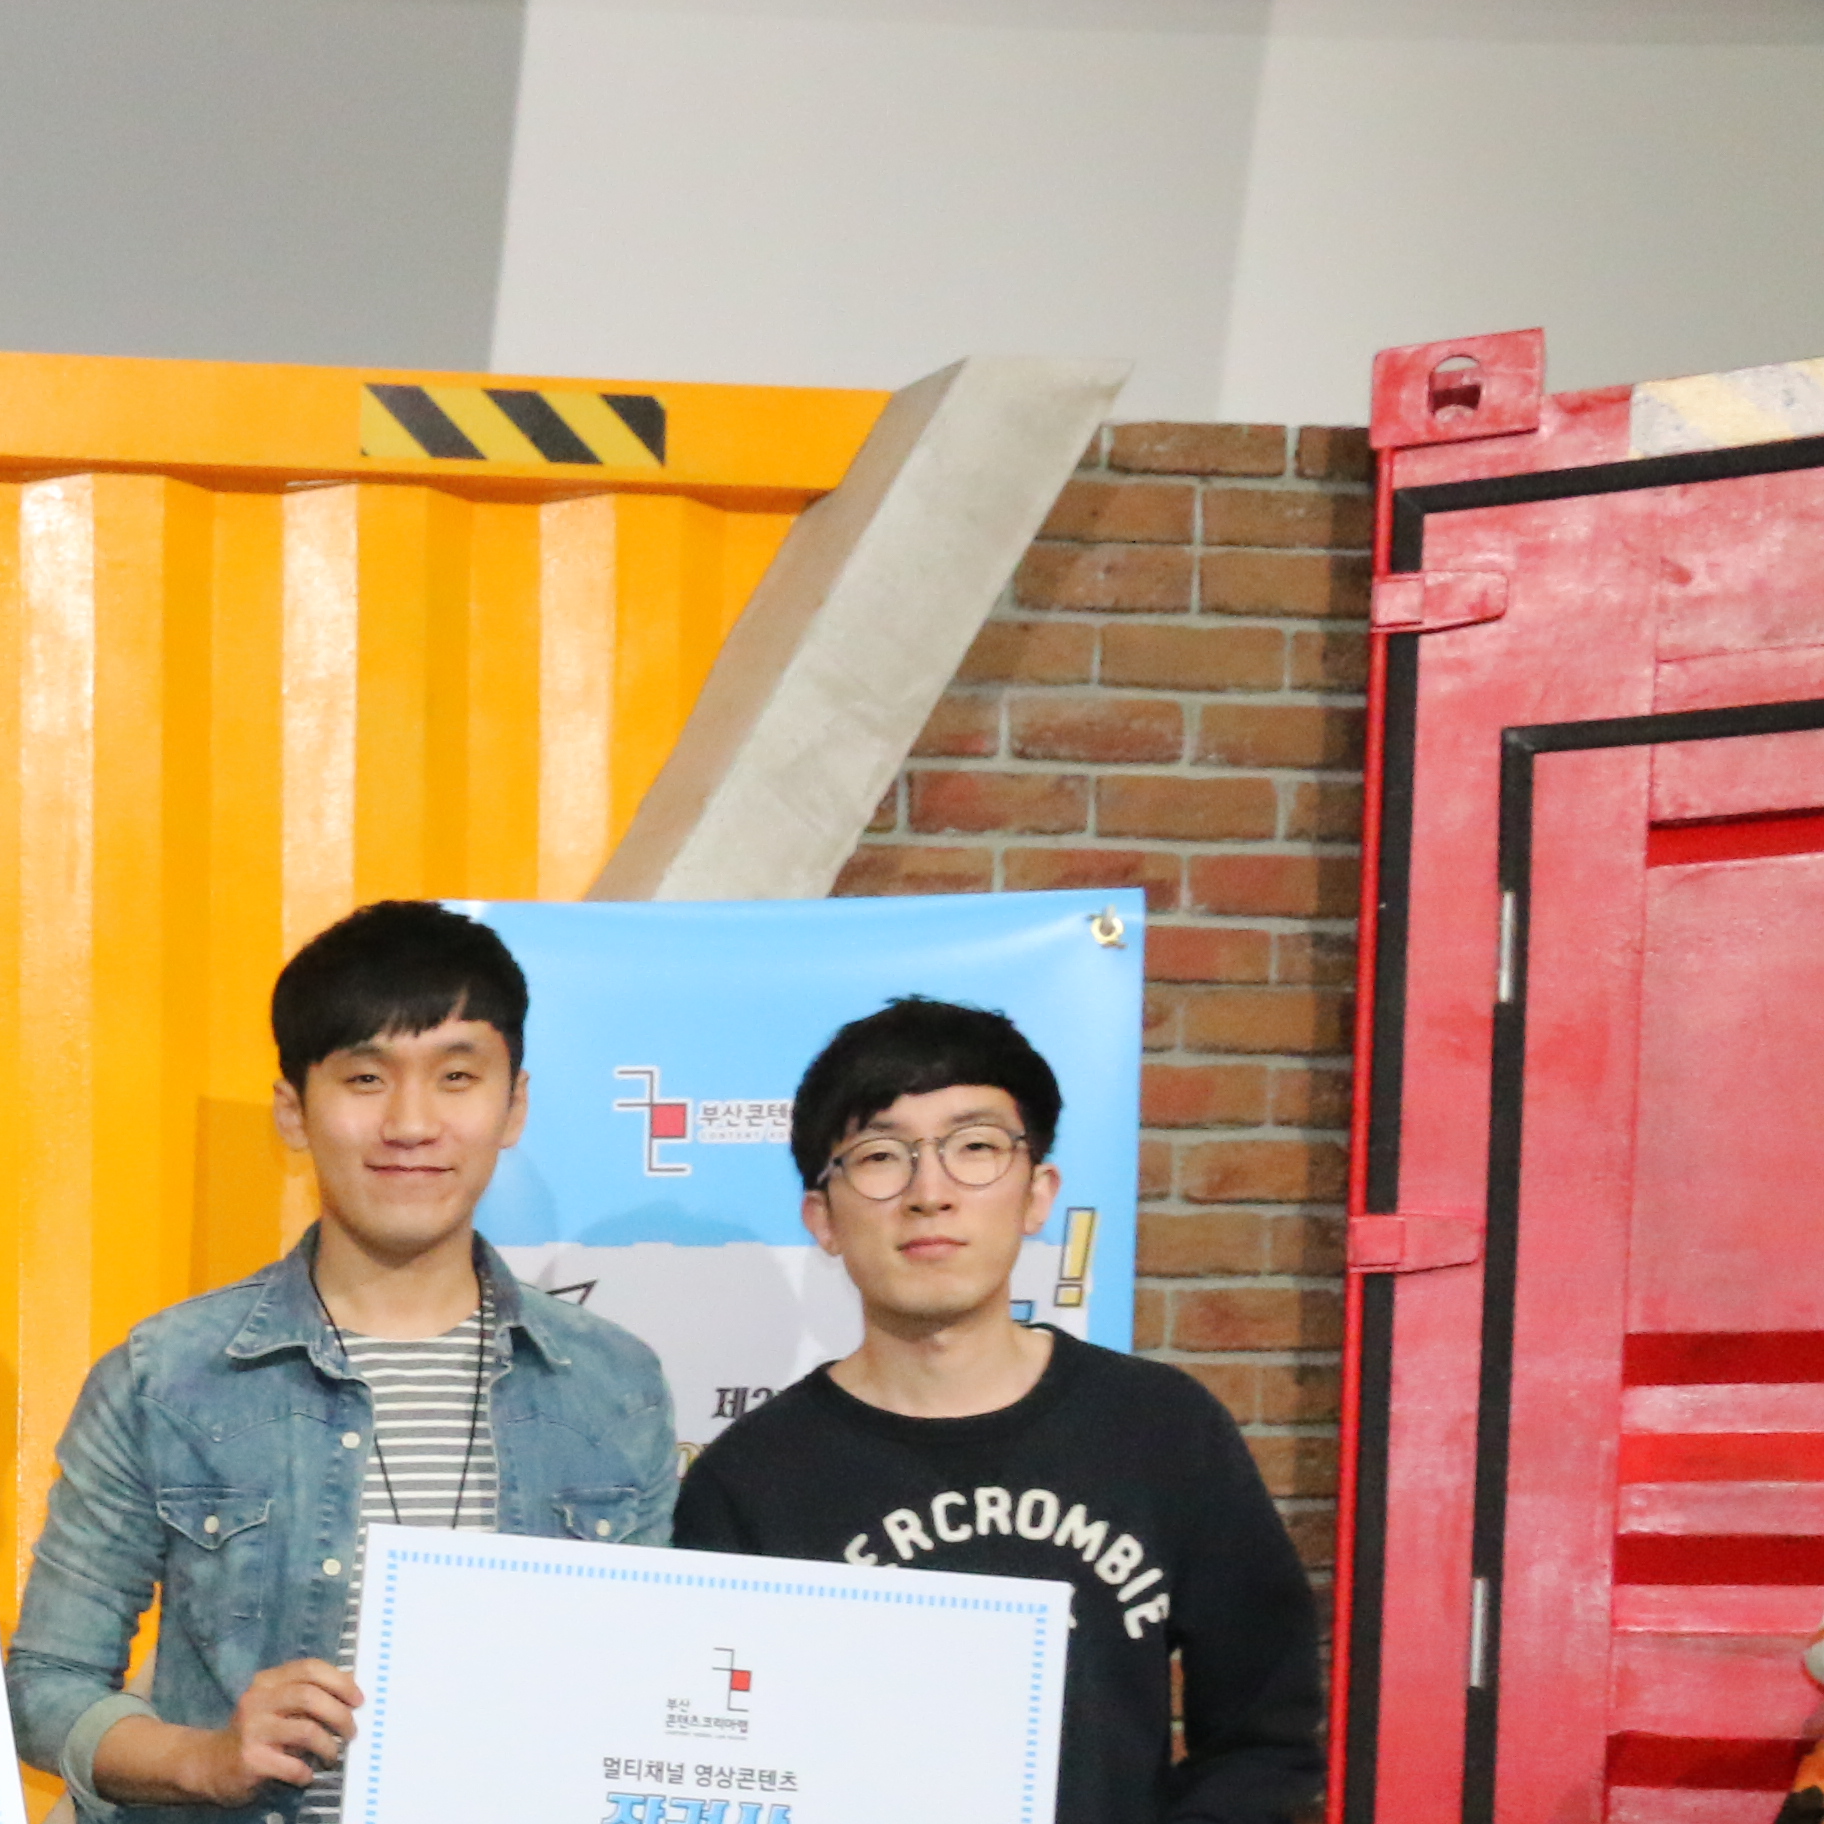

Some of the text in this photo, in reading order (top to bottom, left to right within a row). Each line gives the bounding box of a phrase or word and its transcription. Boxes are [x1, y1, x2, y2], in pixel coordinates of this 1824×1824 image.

[666, 1698, 690, 1713] 부산
[603, 1757, 798, 1792] 멀티채널 영상콘텐츠
